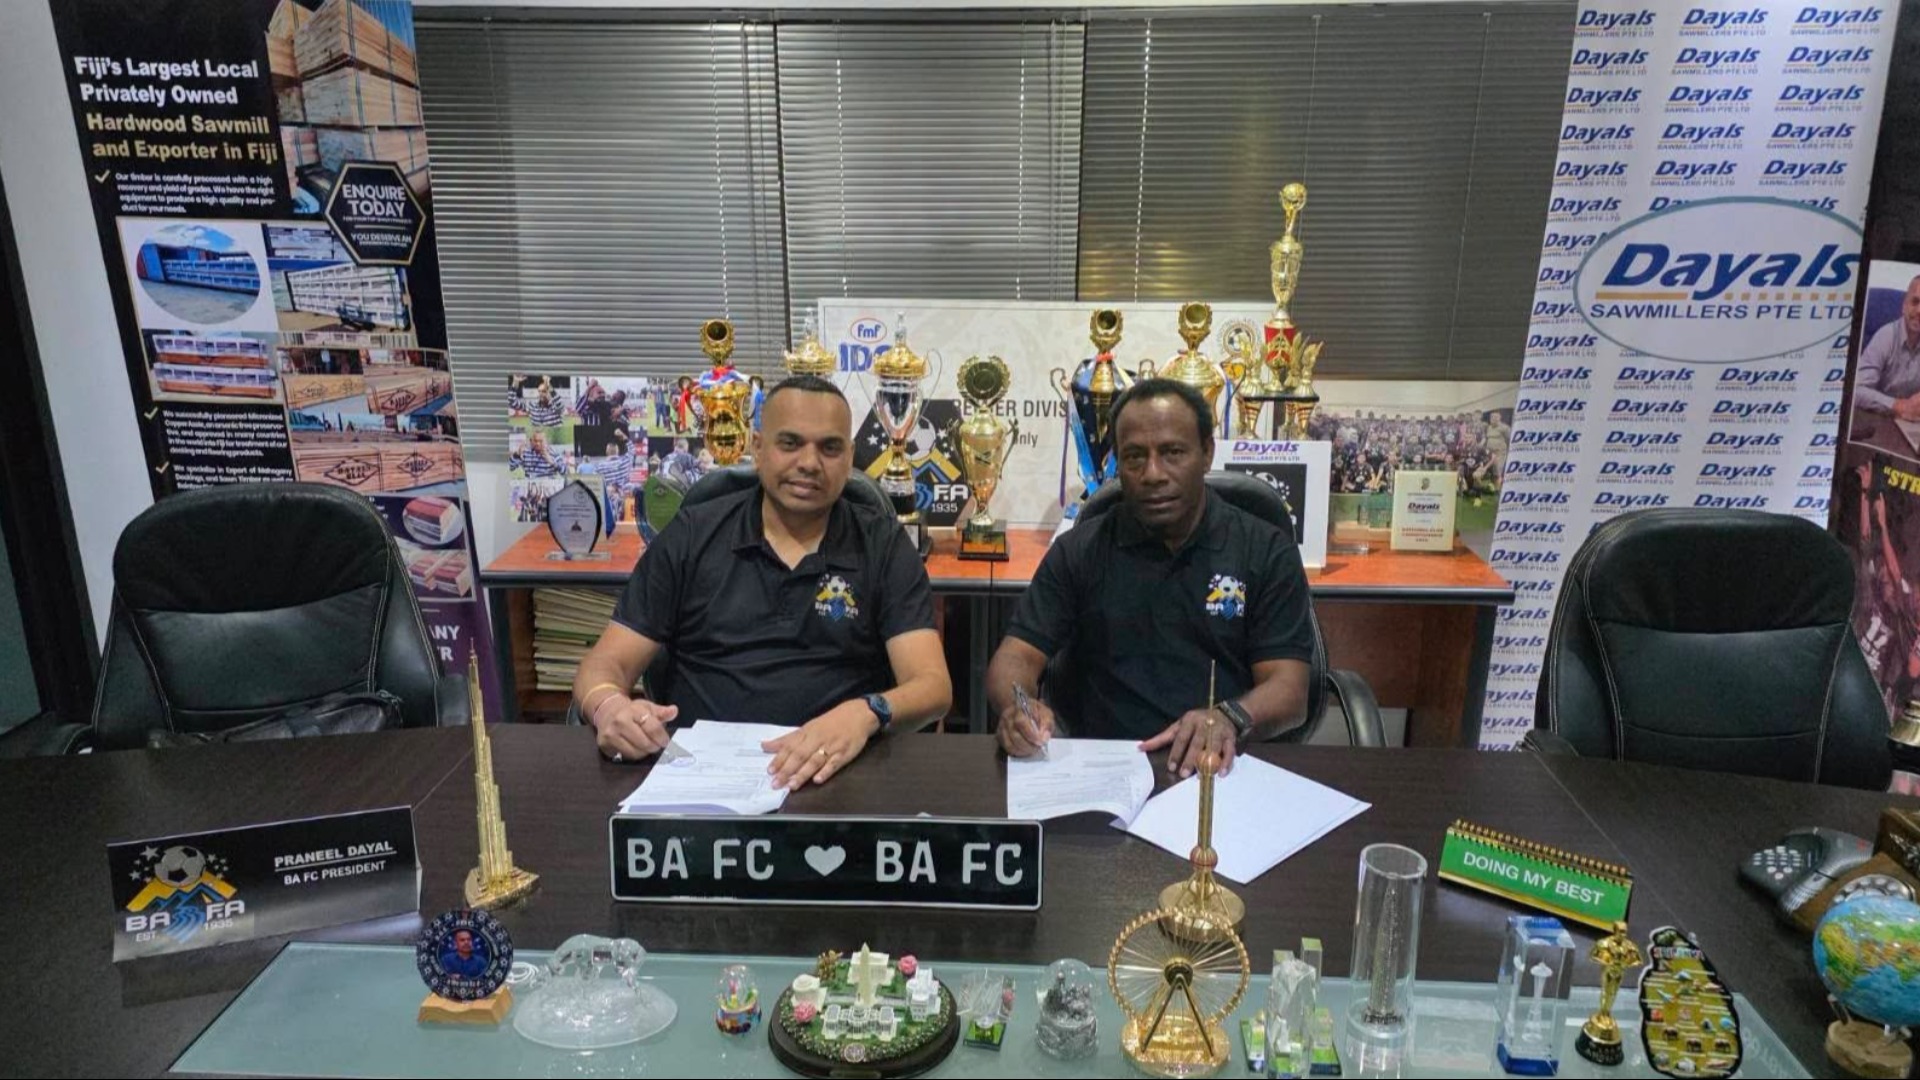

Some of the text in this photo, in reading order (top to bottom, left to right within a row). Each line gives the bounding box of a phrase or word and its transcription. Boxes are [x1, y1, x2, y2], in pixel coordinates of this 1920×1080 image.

[1578, 9, 1656, 30] Dayals
[1683, 8, 1768, 29] Dayals
[1795, 7, 1883, 28] Dayals
[1573, 49, 1649, 69] Dayals
[1676, 47, 1760, 68] Dayals
[1787, 46, 1873, 67] Dayals
[74, 56, 259, 81] Fiji's Largest Local
[80, 83, 238, 107] Privately Owned
[1567, 87, 1641, 107] Dayals
[1669, 86, 1752, 106] Dayals
[1779, 85, 1864, 105] Dayals
[86, 113, 270, 134] Hardwood Sawmill
[1561, 124, 1635, 143] Dayals
[1662, 123, 1744, 143] Dayals
[1771, 123, 1856, 143] Dayals
[92, 140, 278, 164] and Exporter in Fiji
[1556, 161, 1628, 180] Dayals
[1656, 160, 1737, 180] Dayals
[1764, 160, 1847, 179] Dayals
[342, 184, 406, 201] ENQUIRE
[347, 200, 405, 217] TODAY
[1550, 197, 1622, 216] Dayals
[1538, 267, 1577, 283] Day
[1601, 243, 1861, 301] Dayals
[1533, 301, 1579, 318] Day
[1590, 304, 1853, 319] SAWMILLERS PTE LTD
[857, 324, 881, 339] fmf
[1528, 333, 1598, 350] Dayals
[1522, 366, 1592, 383] Dayals
[1617, 367, 1694, 384] Dayals
[1720, 368, 1798, 385] Dayals
[1023, 400, 1069, 417] DIVIS
[1517, 398, 1587, 415] Dayals
[1612, 399, 1688, 416] Dayals
[1713, 400, 1791, 418] Dayals
[1015, 432, 1038, 448] nly
[1511, 429, 1581, 445] Dayals
[1606, 431, 1682, 448] Dayals
[1706, 432, 1783, 449] Dayals
[1233, 441, 1300, 455] Dayals
[1506, 460, 1576, 476] Dayals
[1600, 462, 1675, 478] Dayals
[1699, 463, 1776, 480] Dayals
[1502, 490, 1570, 506] Dayals
[1594, 492, 1669, 508] Dayals
[1694, 494, 1769, 509] Dayals
[932, 502, 958, 513] 1935
[1495, 520, 1566, 535] Dayals
[1490, 549, 1561, 564] Dayals
[1506, 579, 1555, 592] yals
[1497, 608, 1550, 621] ayals
[1493, 635, 1545, 648] ayals
[437, 645, 454, 661] R
[1489, 662, 1540, 676] ayals
[1485, 689, 1535, 703] ayals
[1482, 716, 1531, 729] ayals
[274, 841, 394, 868] PRANEEL DAYAL
[626, 837, 1023, 885] BA FC BA FC
[284, 860, 386, 885] BA FC PRESIDENT
[1463, 851, 1605, 906] DOING MY BEST
[126, 912, 170, 932] BA
[136, 918, 234, 942] EST 1935
